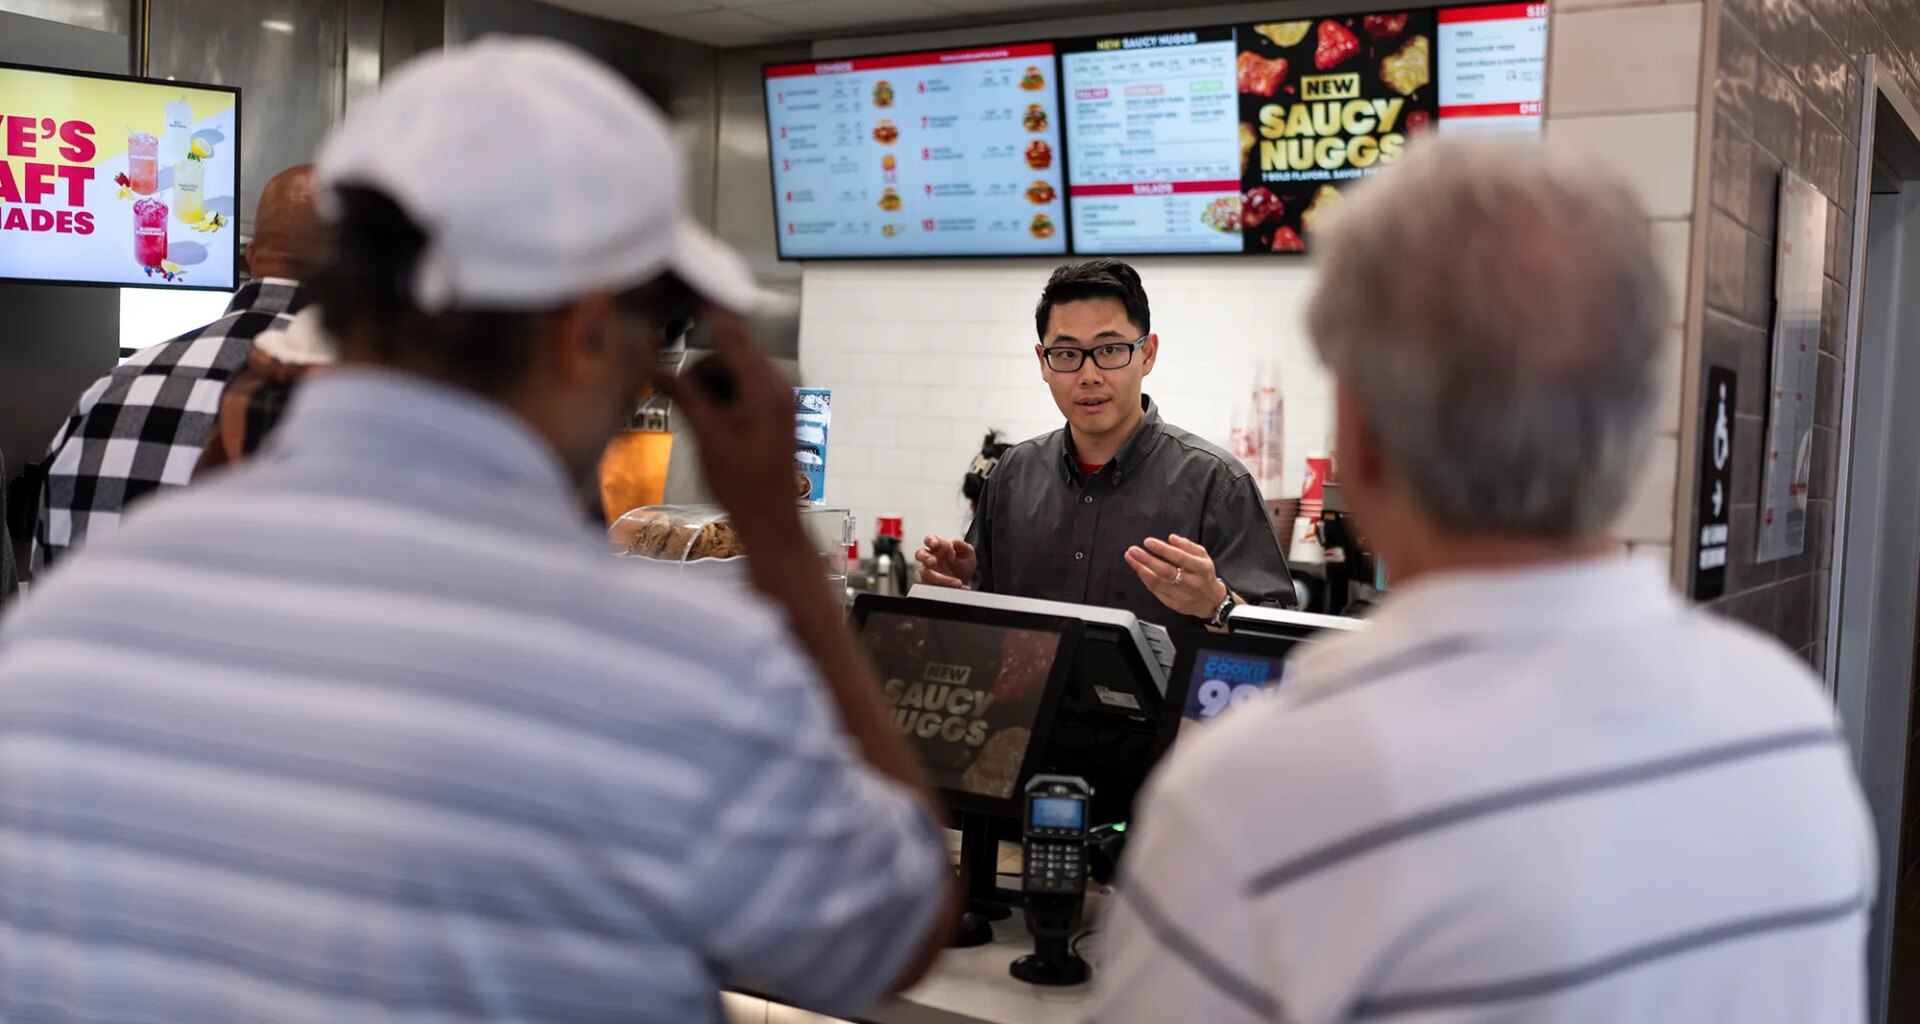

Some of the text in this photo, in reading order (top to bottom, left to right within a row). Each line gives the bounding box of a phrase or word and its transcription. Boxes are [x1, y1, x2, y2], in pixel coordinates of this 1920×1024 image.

[1307, 79, 1353, 96] NEW
[1259, 98, 1404, 139] SAUCY
[0, 114, 96, 163] E'S
[1260, 133, 1405, 171] NUGGS
[0, 206, 95, 236] ADES
[926, 665, 968, 683] NEW
[885, 678, 995, 717] SAUCY
